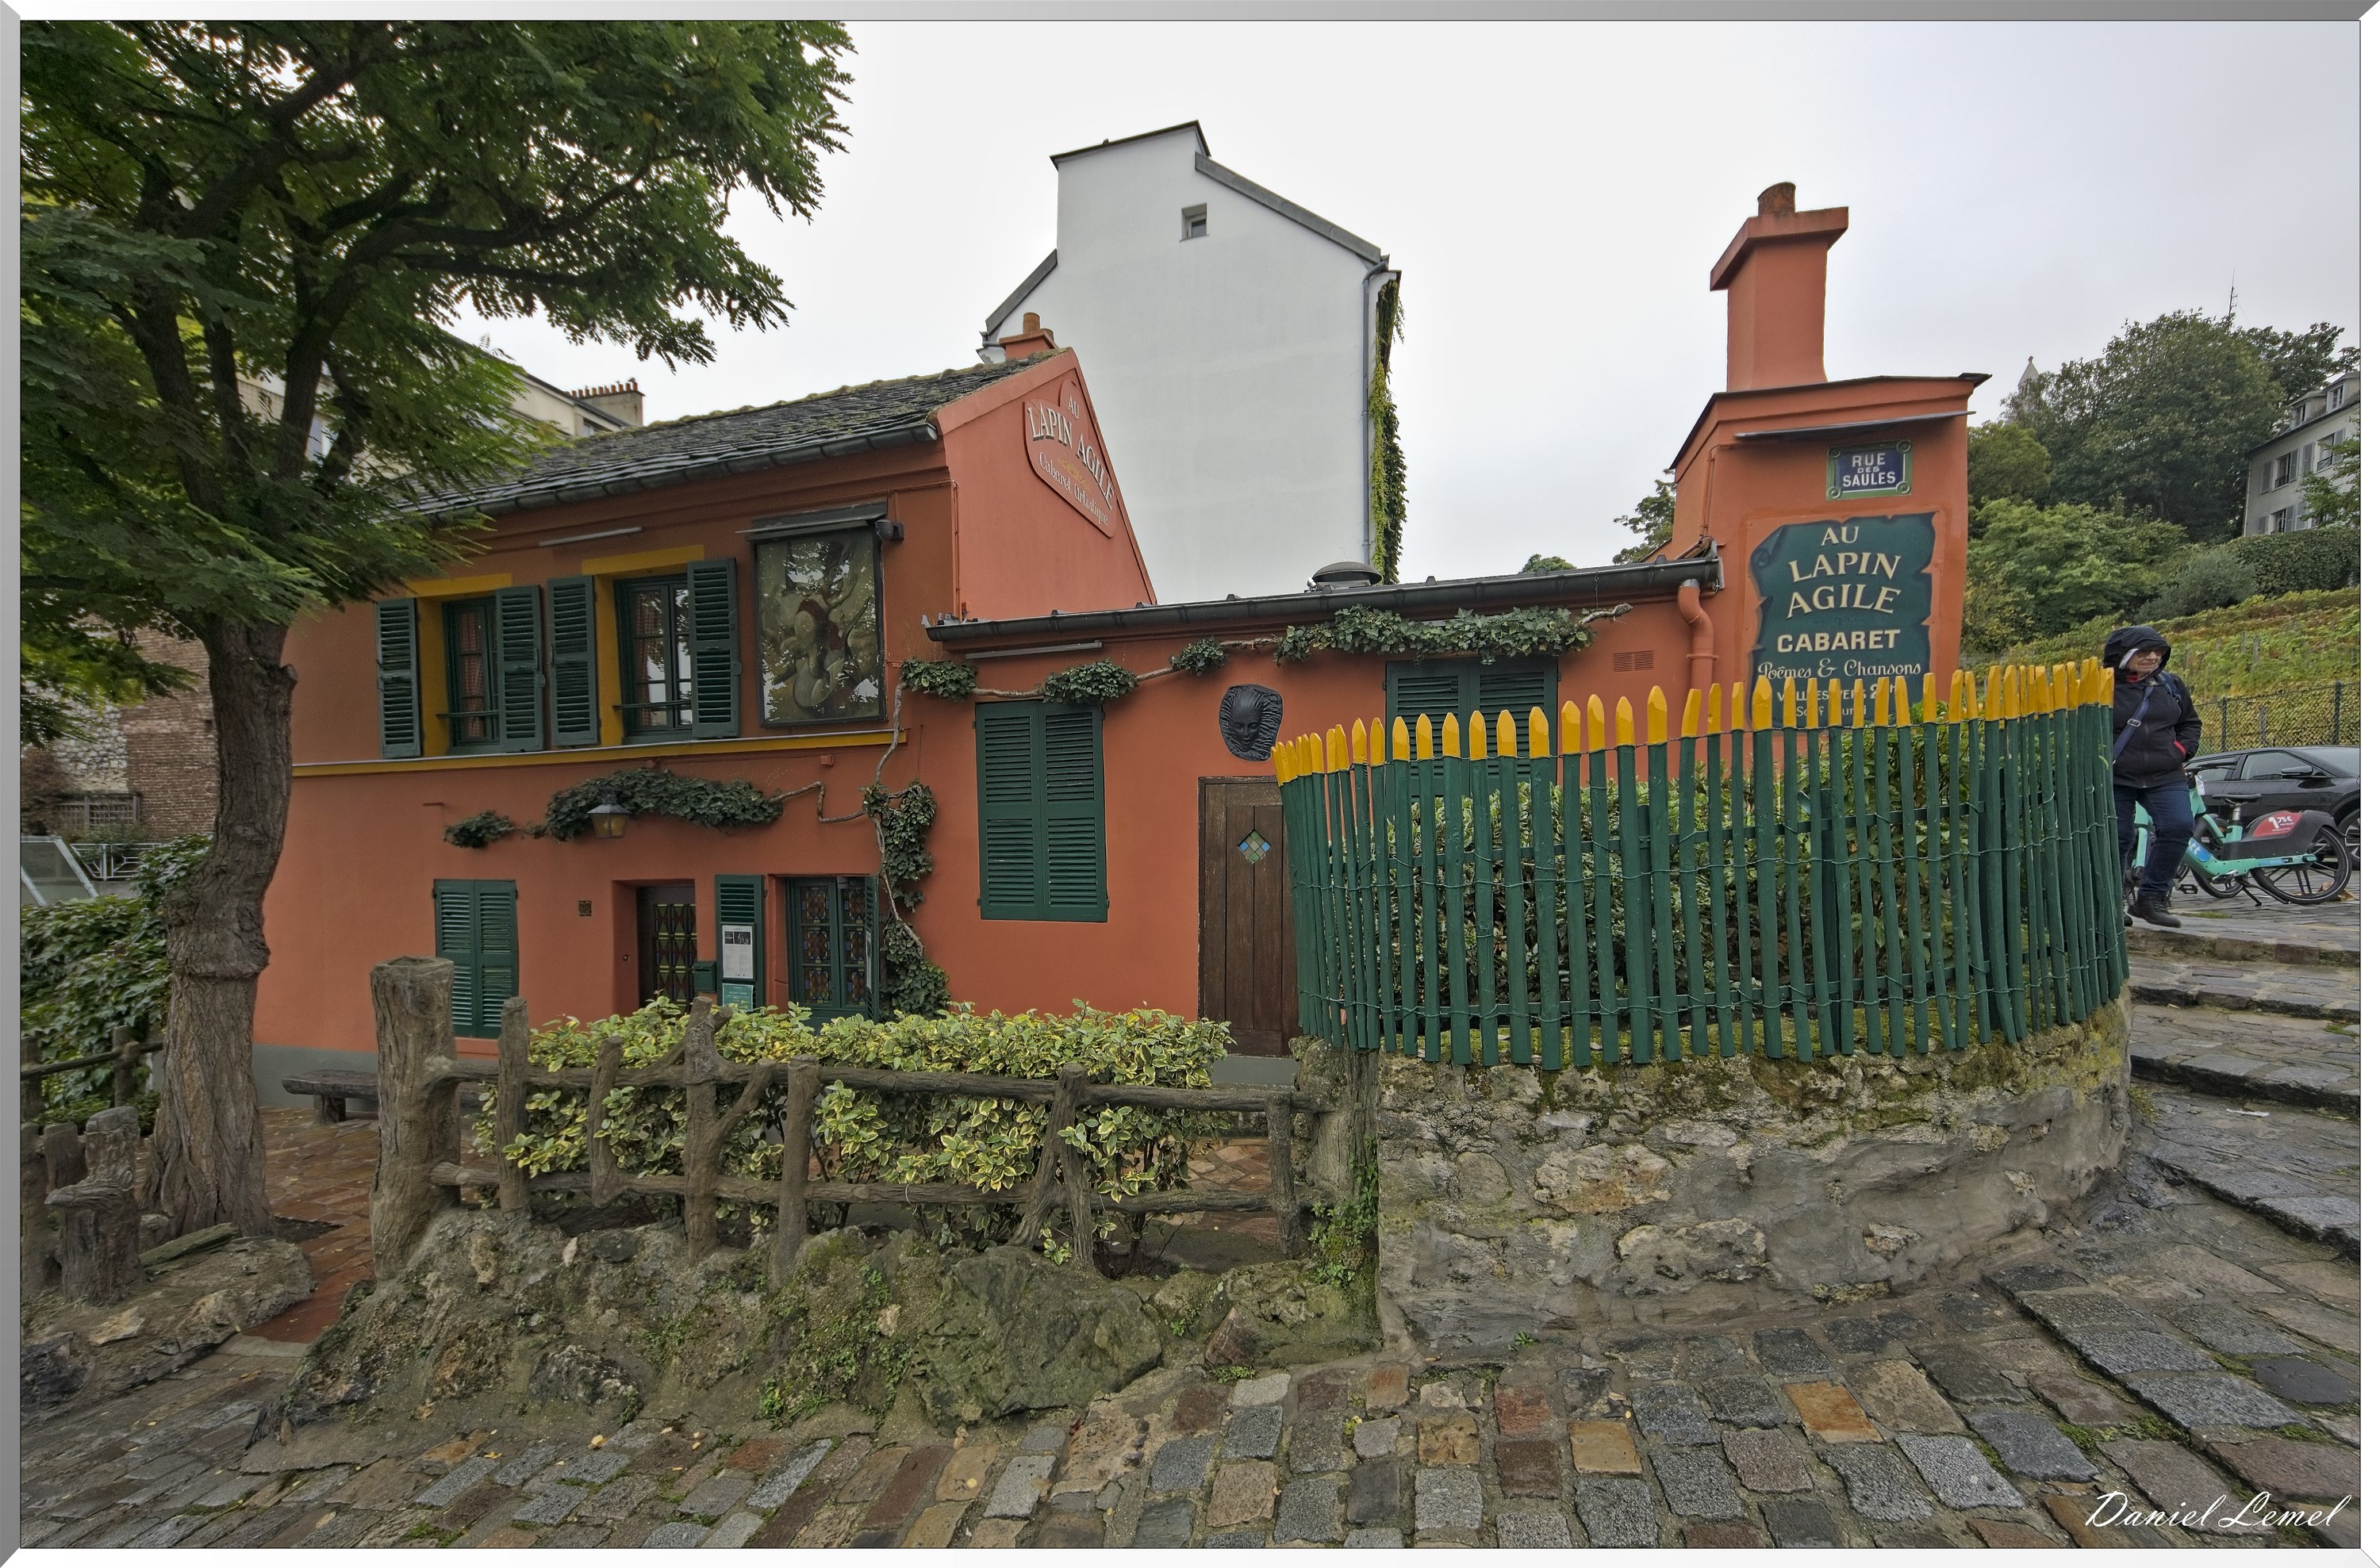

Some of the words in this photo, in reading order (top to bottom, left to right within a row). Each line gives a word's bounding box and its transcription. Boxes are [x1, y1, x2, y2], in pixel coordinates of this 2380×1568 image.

[1067, 395, 1079, 420] AU
[1027, 404, 1073, 450] LAPIN
[1076, 433, 1115, 511] AGILE
[1852, 453, 1886, 467] RUE
[1039, 452, 1073, 494] Cabaret
[1842, 471, 1896, 487] SAULES
[1821, 526, 1860, 546] AU
[1788, 552, 1902, 582] LAPIN
[1787, 583, 1902, 618] AGILE
[1777, 629, 1901, 653] CABARET
[1818, 657, 1837, 677] &
[1844, 659, 1921, 676] Chansons
